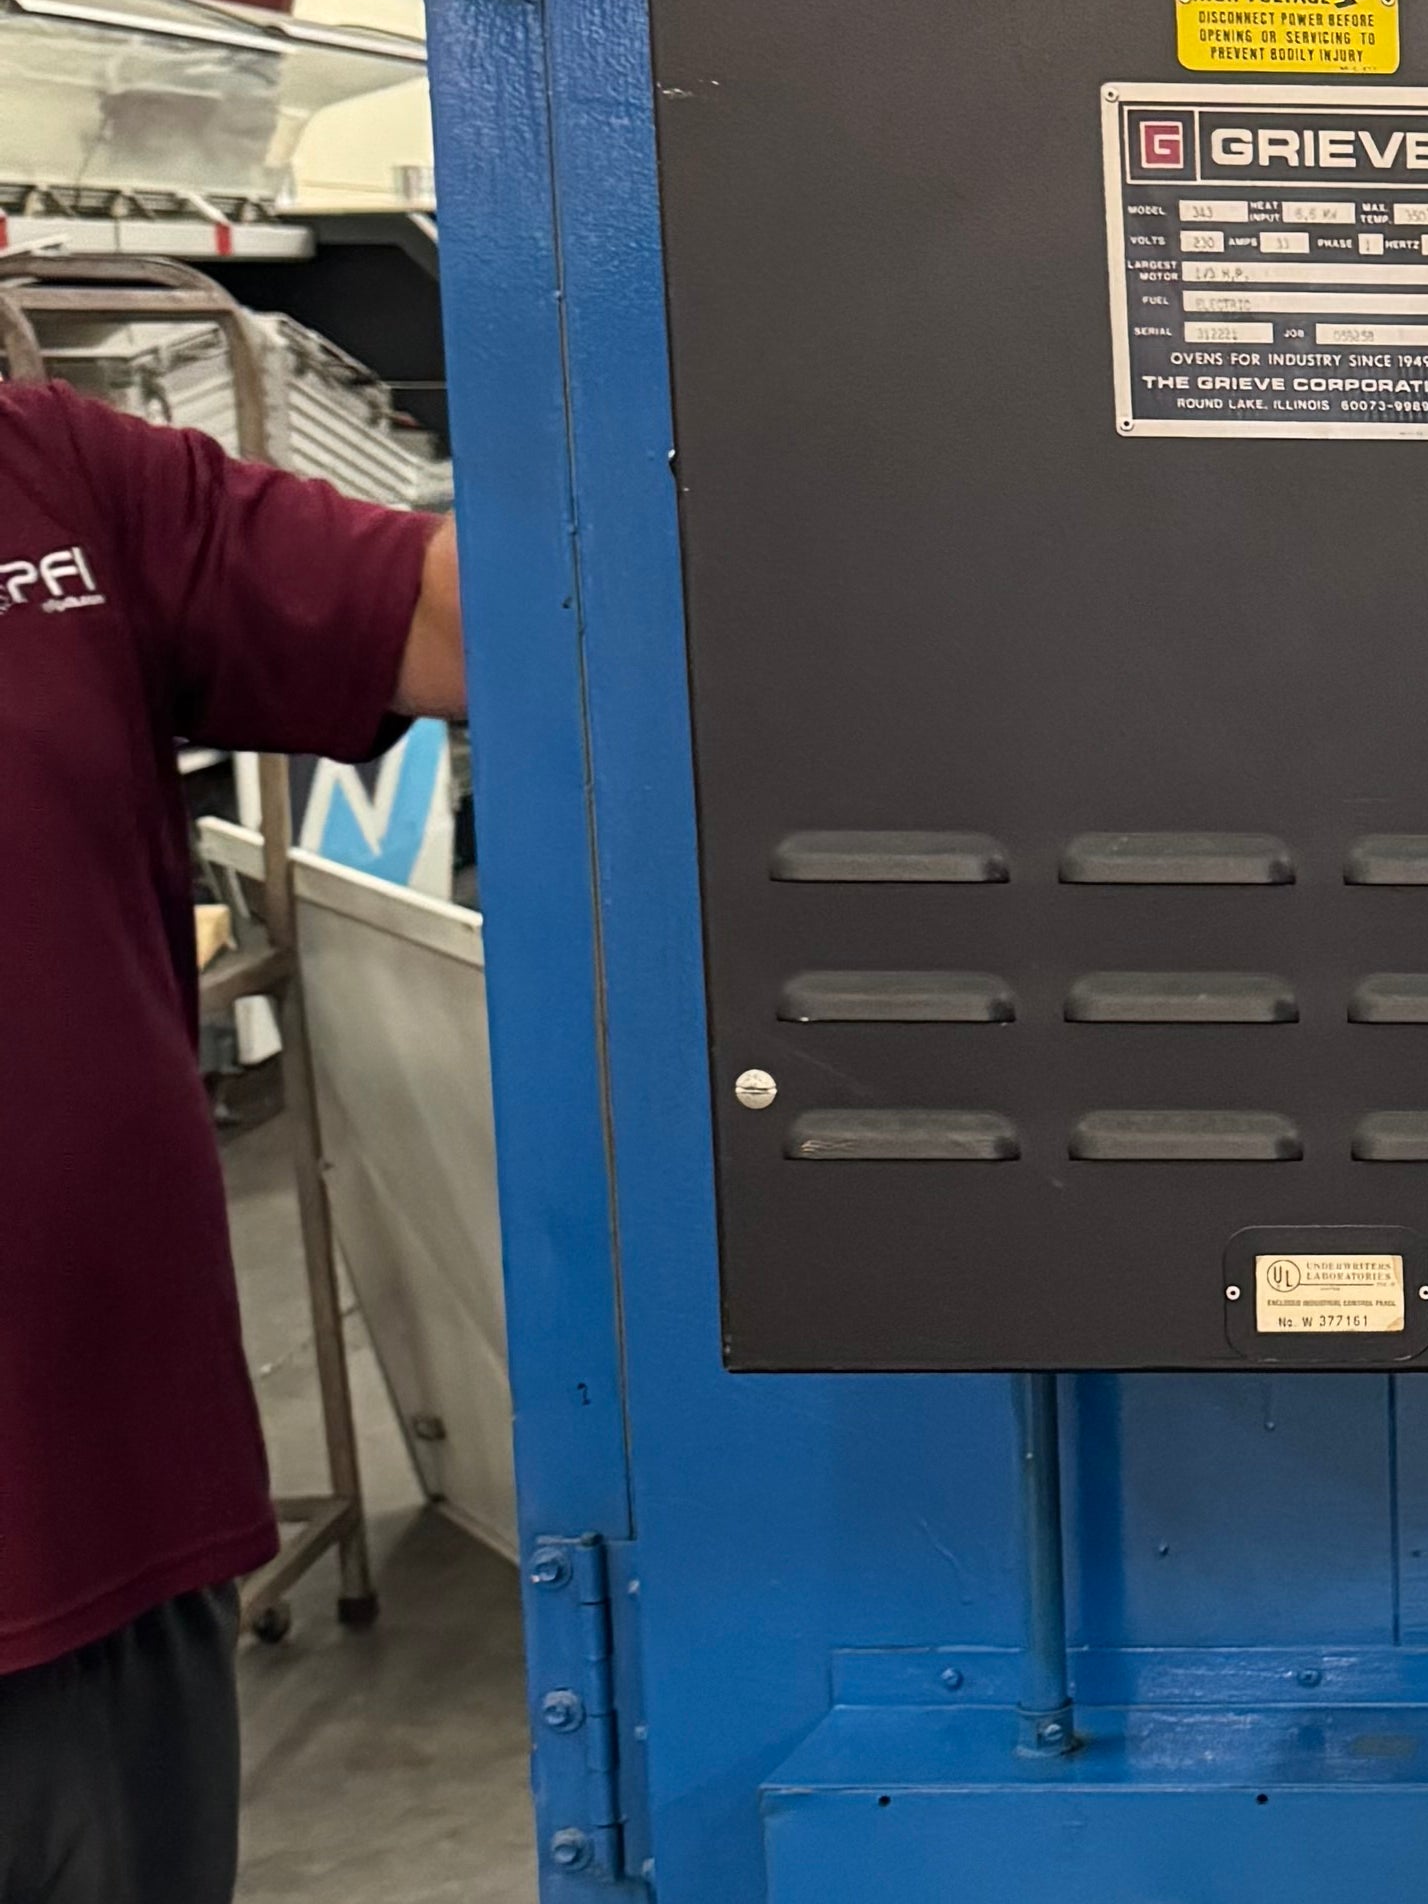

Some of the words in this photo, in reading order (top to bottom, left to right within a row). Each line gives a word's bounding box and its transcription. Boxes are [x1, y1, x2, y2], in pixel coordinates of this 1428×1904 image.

[1199, 11, 1275, 25] DISCONNECT
[1281, 13, 1323, 26] POWER
[1328, 14, 1375, 27] BEFORE
[1199, 29, 1252, 43] OPENING
[1262, 30, 1277, 43] OR
[1286, 31, 1351, 44] SERVICING
[1361, 32, 1376, 45] TO
[1211, 47, 1264, 60] PREVENT
[1270, 48, 1314, 61] BODILY
[1320, 49, 1363, 62] INJURY
[1127, 206, 1166, 216] MODEL
[1250, 201, 1279, 210] HEAT
[1250, 213, 1280, 222] INPUT
[1129, 236, 1166, 246] VOLTS
[1193, 236, 1214, 249] 230
[1228, 237, 1258, 247] AMPS
[1317, 239, 1353, 248] PHASE
[1385, 240, 1420, 249] HERTZ
[1127, 261, 1177, 270] LARGEST
[1139, 272, 1179, 281] MOTOR
[1142, 296, 1169, 305] FUEL
[1195, 298, 1252, 312] ELECTRIC
[1134, 326, 1172, 337] SERIAL
[1283, 329, 1305, 338] JOB
[1170, 352, 1223, 366] OVENS
[1231, 353, 1260, 366] FOR
[1268, 354, 1342, 367] INDUSTRY
[1349, 355, 1391, 368] SINCE
[1142, 376, 1190, 389] THE
[1197, 377, 1285, 391] GRIEVE
[1177, 398, 1223, 409] ROUND
[1273, 400, 1330, 411] ILLINOIS
[1306, 1261, 1392, 1271] UNDERWRITERS
[1306, 1272, 1392, 1281] LABORATORIES
[1302, 1317, 1313, 1327] W
